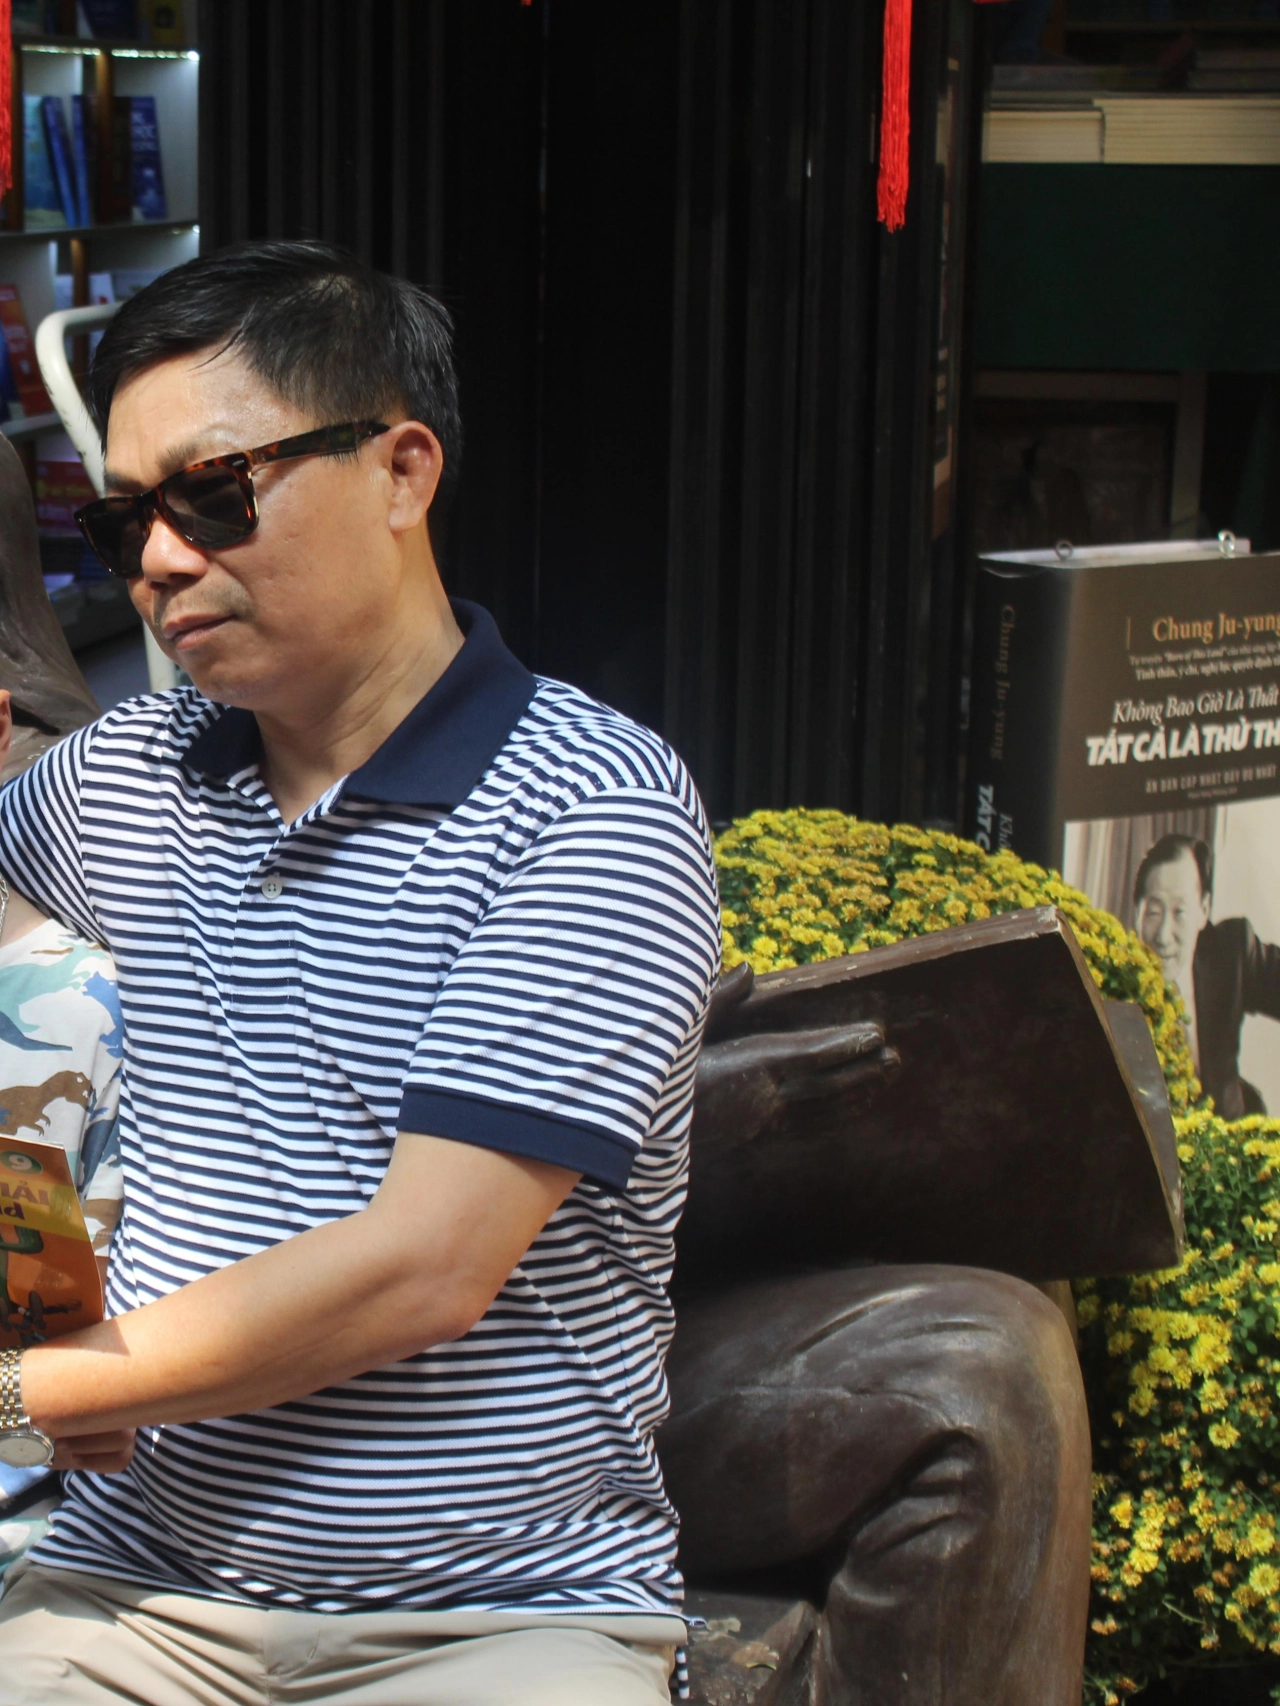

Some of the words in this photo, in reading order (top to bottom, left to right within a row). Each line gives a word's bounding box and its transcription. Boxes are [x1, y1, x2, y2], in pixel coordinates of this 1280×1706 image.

[1151, 615, 1214, 645] Chung
[1113, 699, 1164, 726] Không
[1166, 694, 1195, 718] Bao
[1225, 686, 1245, 712] Là
[1132, 722, 1167, 763] CẢ
[1168, 720, 1201, 759] LÀ
[15, 1152, 34, 1172] 9
